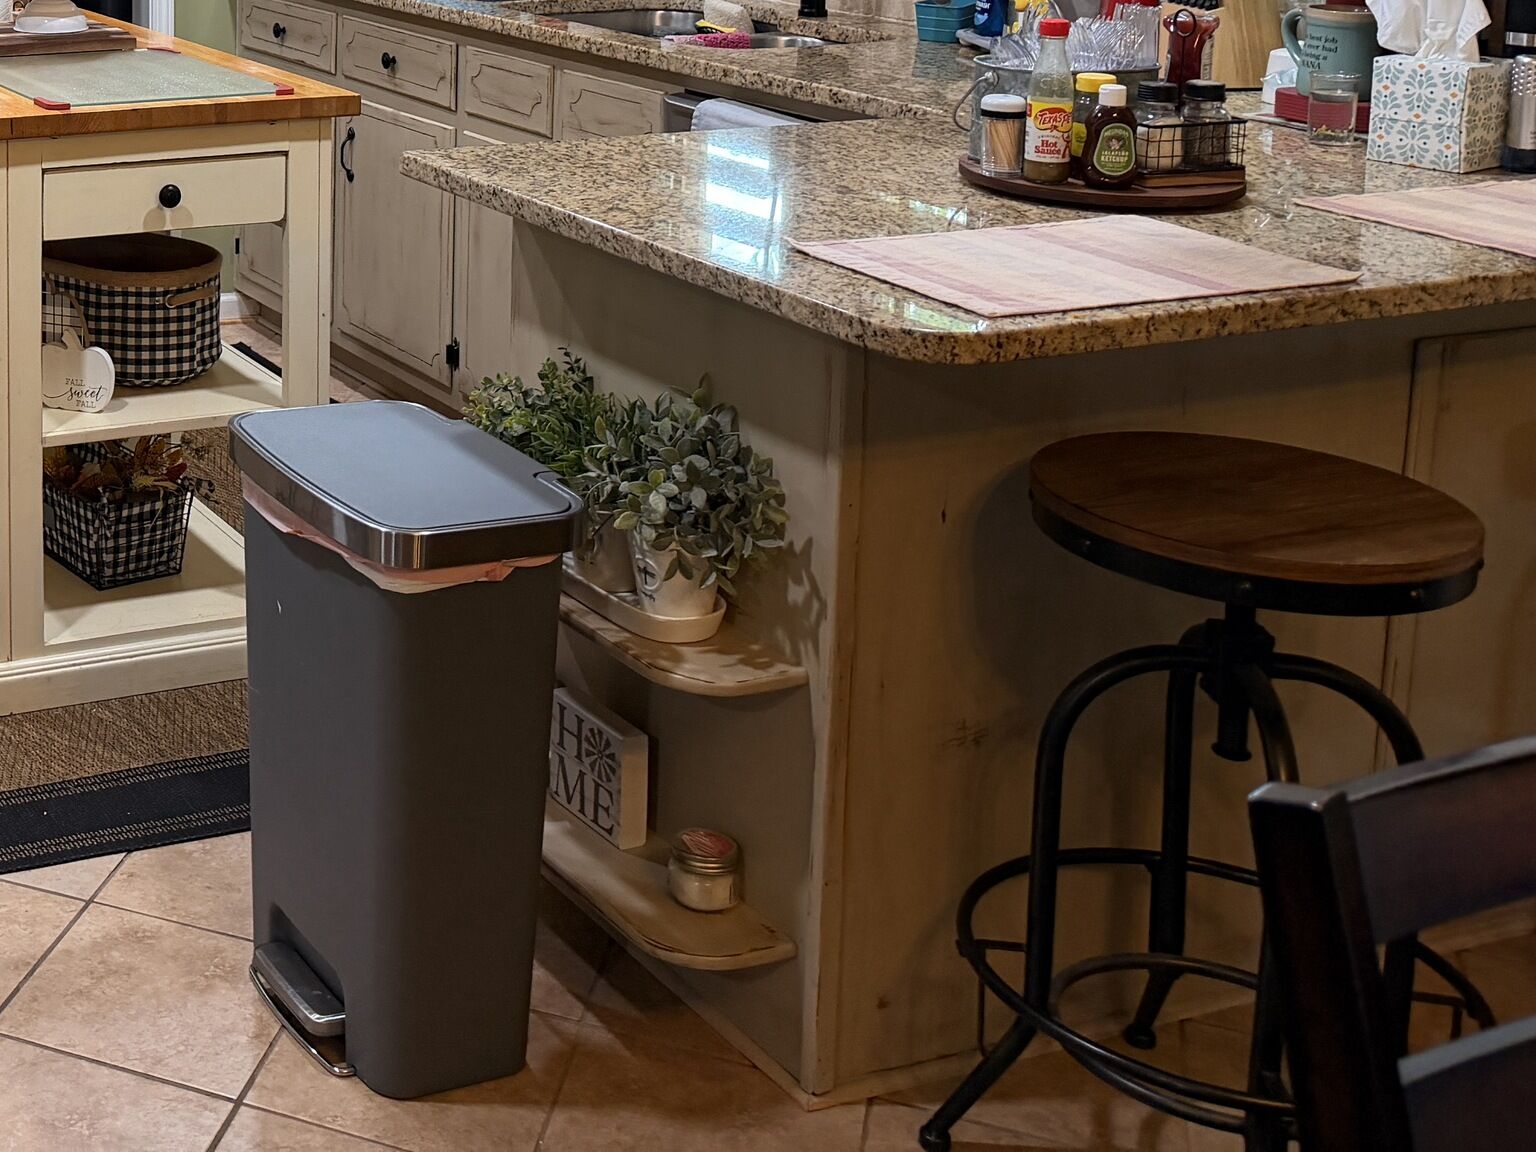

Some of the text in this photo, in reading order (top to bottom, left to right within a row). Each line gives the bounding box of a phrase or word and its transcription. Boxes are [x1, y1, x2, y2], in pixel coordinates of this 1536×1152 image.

[1036, 110, 1063, 125] TEXAS
[1040, 139, 1058, 148] Hot
[1034, 145, 1062, 156] Sauce
[65, 377, 85, 387] FALL
[66, 384, 107, 402] sweet
[75, 399, 96, 409] FALL
[554, 752, 615, 837] ME
